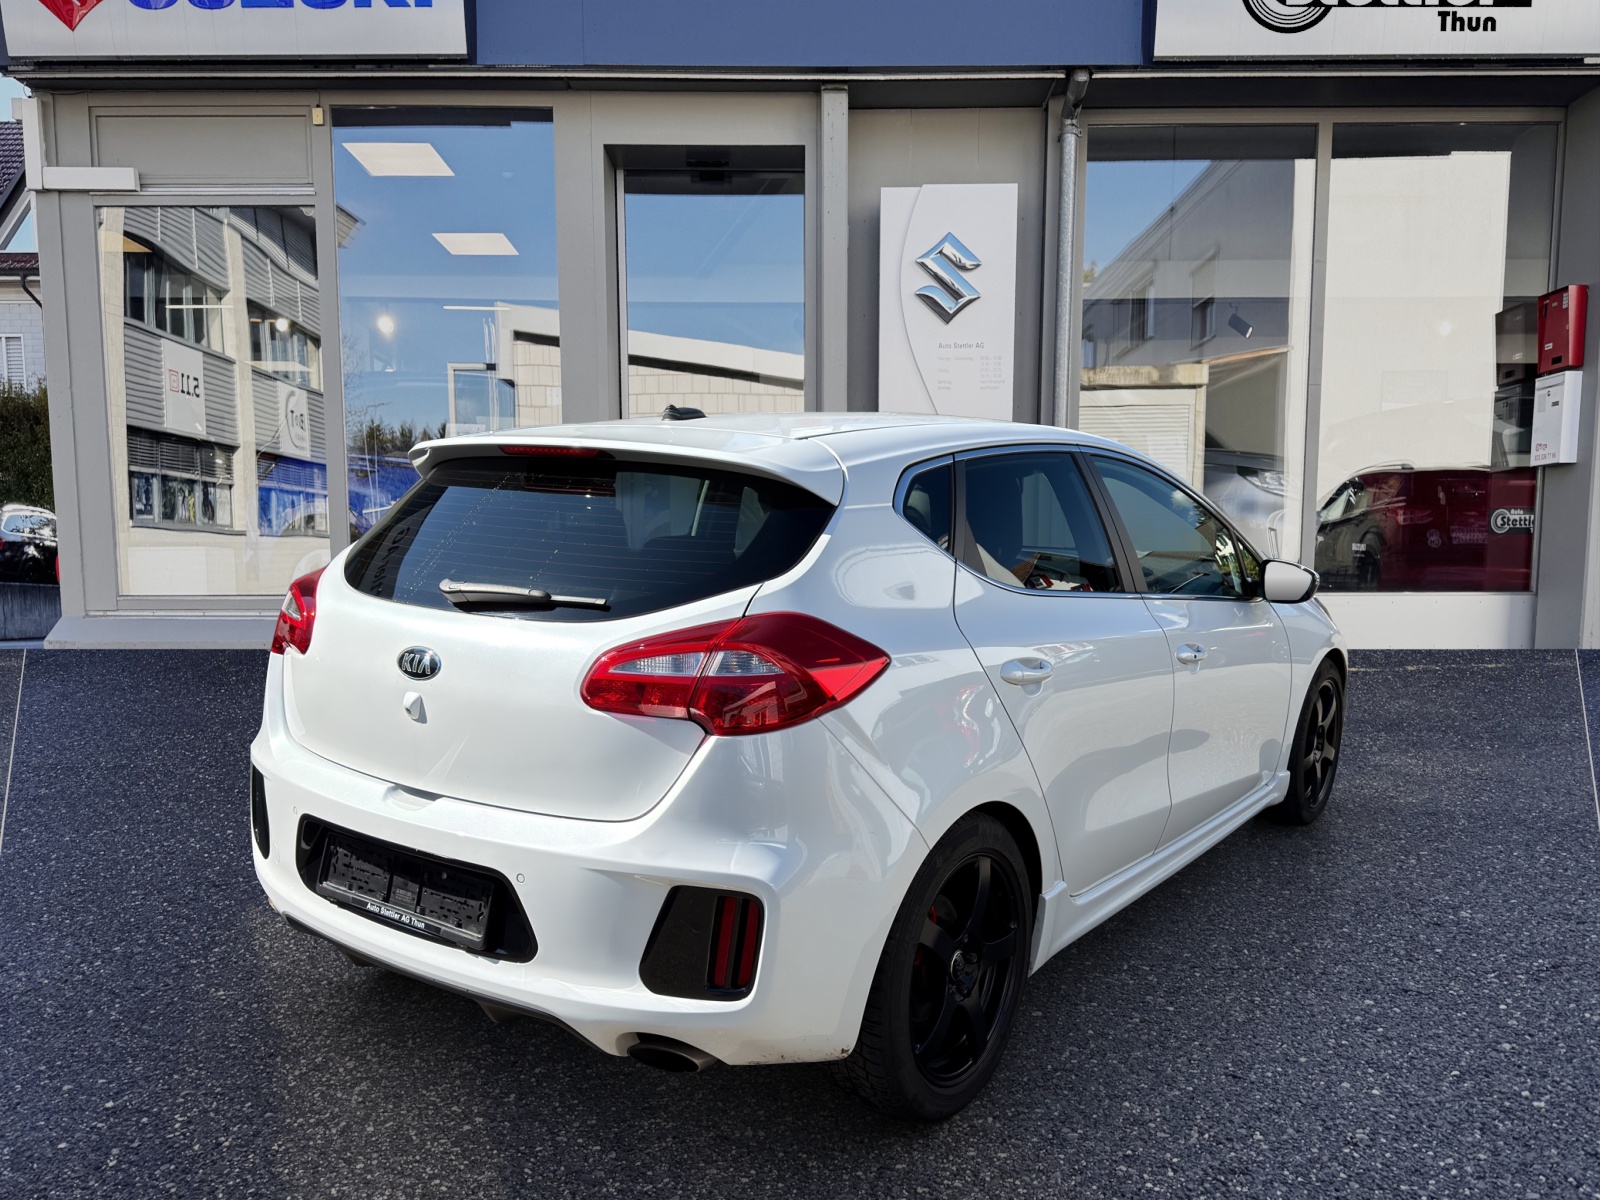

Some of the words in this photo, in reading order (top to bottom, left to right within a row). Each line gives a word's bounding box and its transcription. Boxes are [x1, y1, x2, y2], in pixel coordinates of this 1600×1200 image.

[1438, 11, 1497, 32] Thun
[401, 652, 431, 674] KIA
[366, 902, 380, 913] Auto
[380, 907, 401, 920] Stettler
[400, 914, 411, 923] AG
[411, 917, 425, 929] Thun
